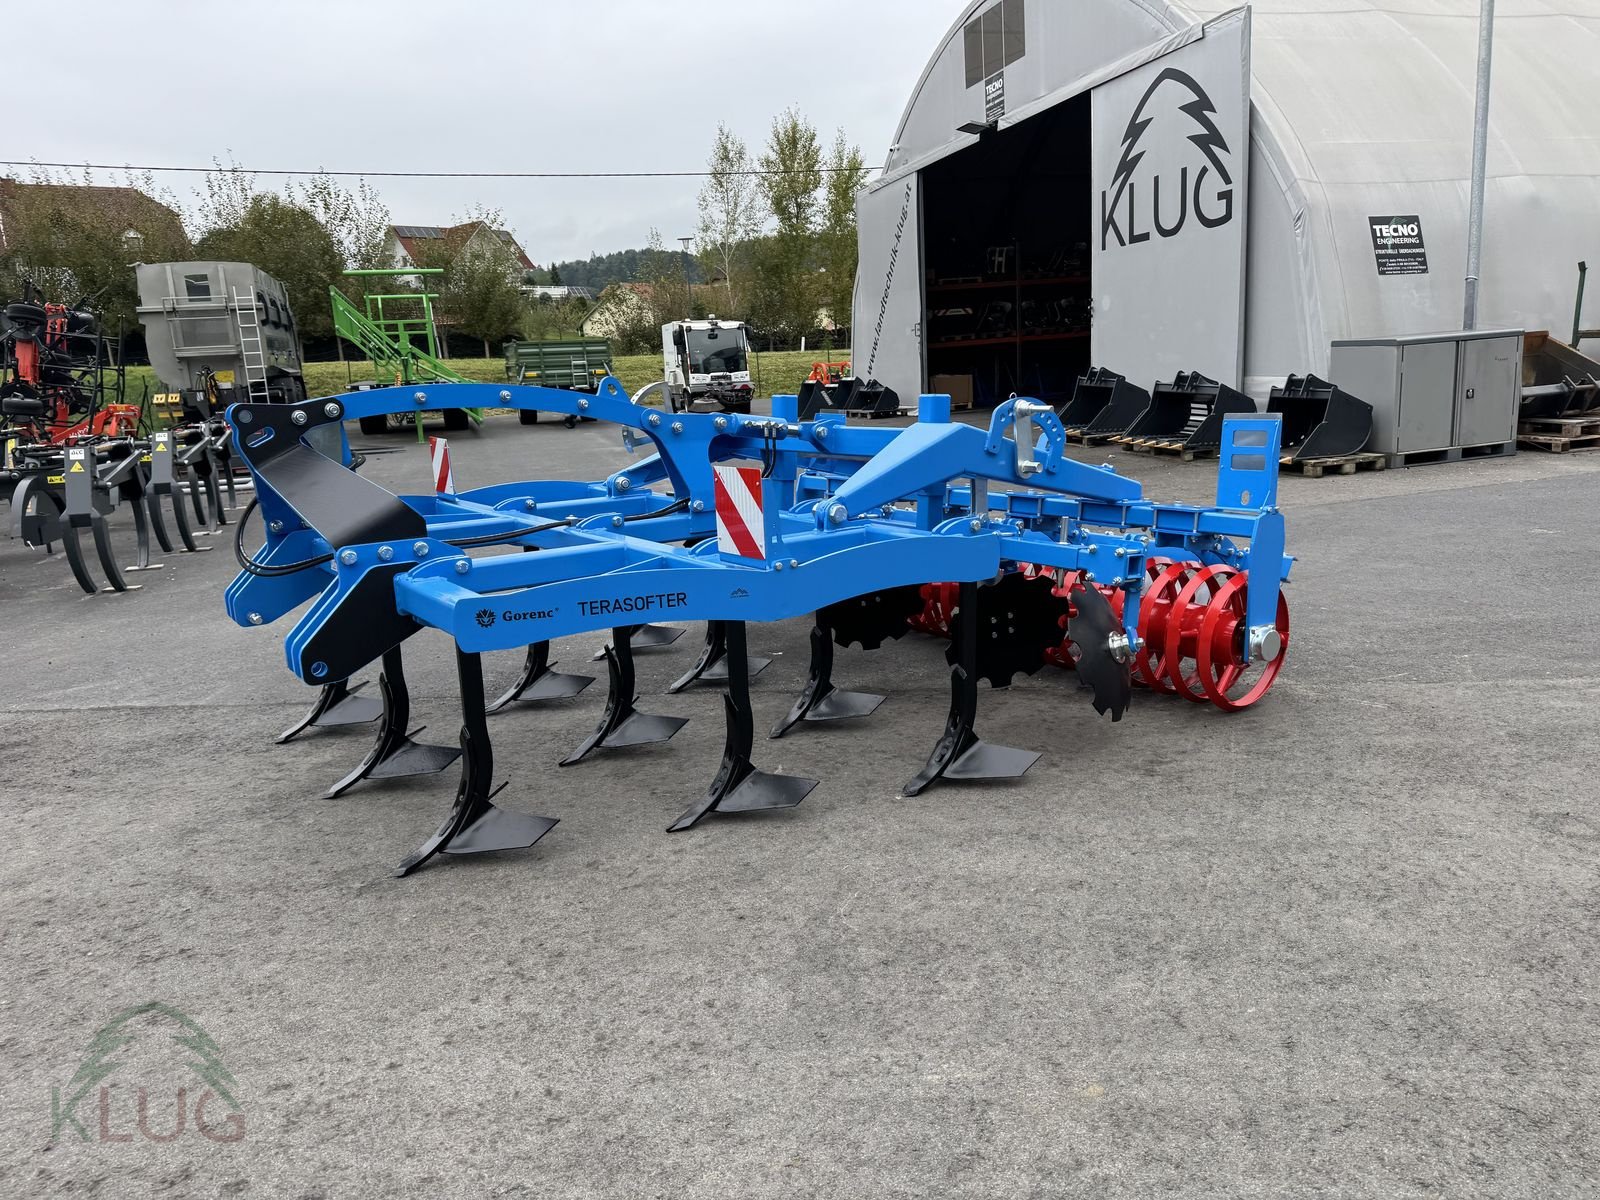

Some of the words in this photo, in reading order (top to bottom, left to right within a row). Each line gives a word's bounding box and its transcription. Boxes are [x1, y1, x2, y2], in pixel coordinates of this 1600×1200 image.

[986, 79, 1002, 95] TECNO
[1101, 165, 1233, 251] KLUG
[1372, 224, 1418, 236] TECNO
[867, 182, 912, 376] www.landtechnik-klug.at
[502, 609, 554, 622] Gorenc
[577, 592, 688, 616] TERASOFTER
